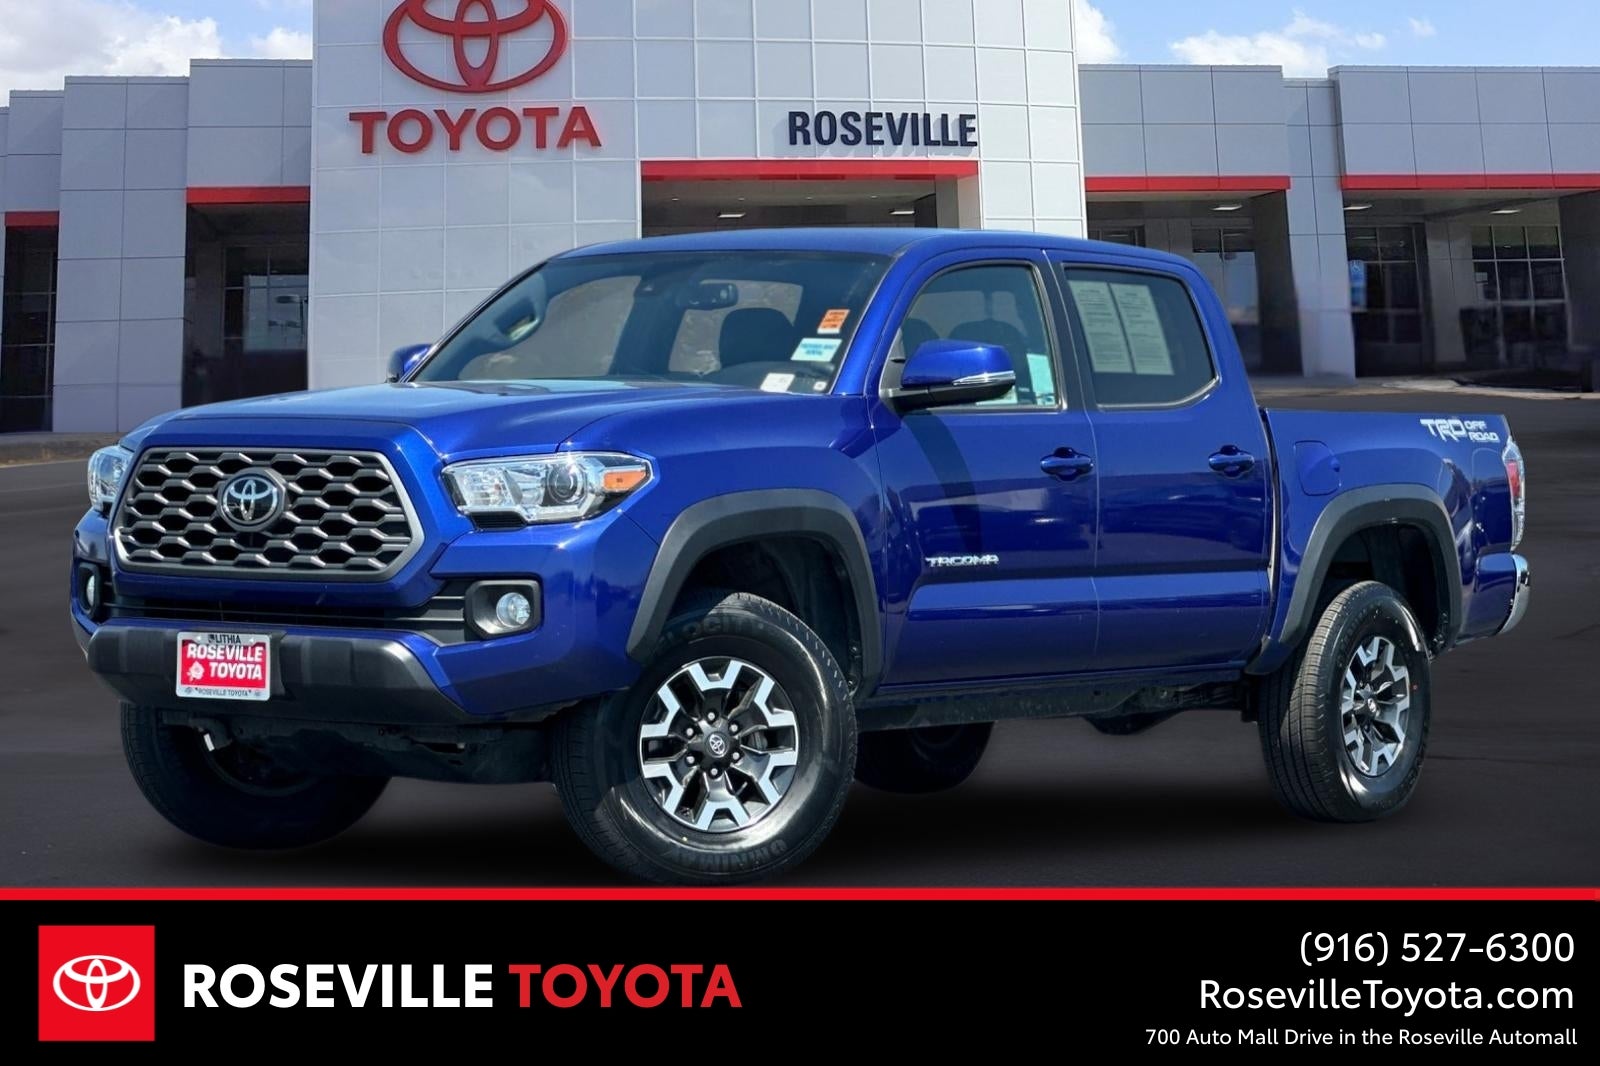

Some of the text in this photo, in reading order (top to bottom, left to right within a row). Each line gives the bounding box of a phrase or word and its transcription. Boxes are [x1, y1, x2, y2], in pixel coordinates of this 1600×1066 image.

[349, 106, 602, 154] TOYOTA
[788, 110, 979, 148] ROSEVILLE
[1419, 418, 1468, 443] TRD
[1463, 420, 1488, 431] OFF
[1468, 431, 1501, 443] ROAD
[924, 554, 1000, 568] TACOMA
[215, 634, 242, 644] LITHIA
[186, 643, 264, 662] ROSEVILLE
[208, 661, 263, 680] TOYOTA
[198, 688, 249, 697] ROSEVILLE TOYOTA
